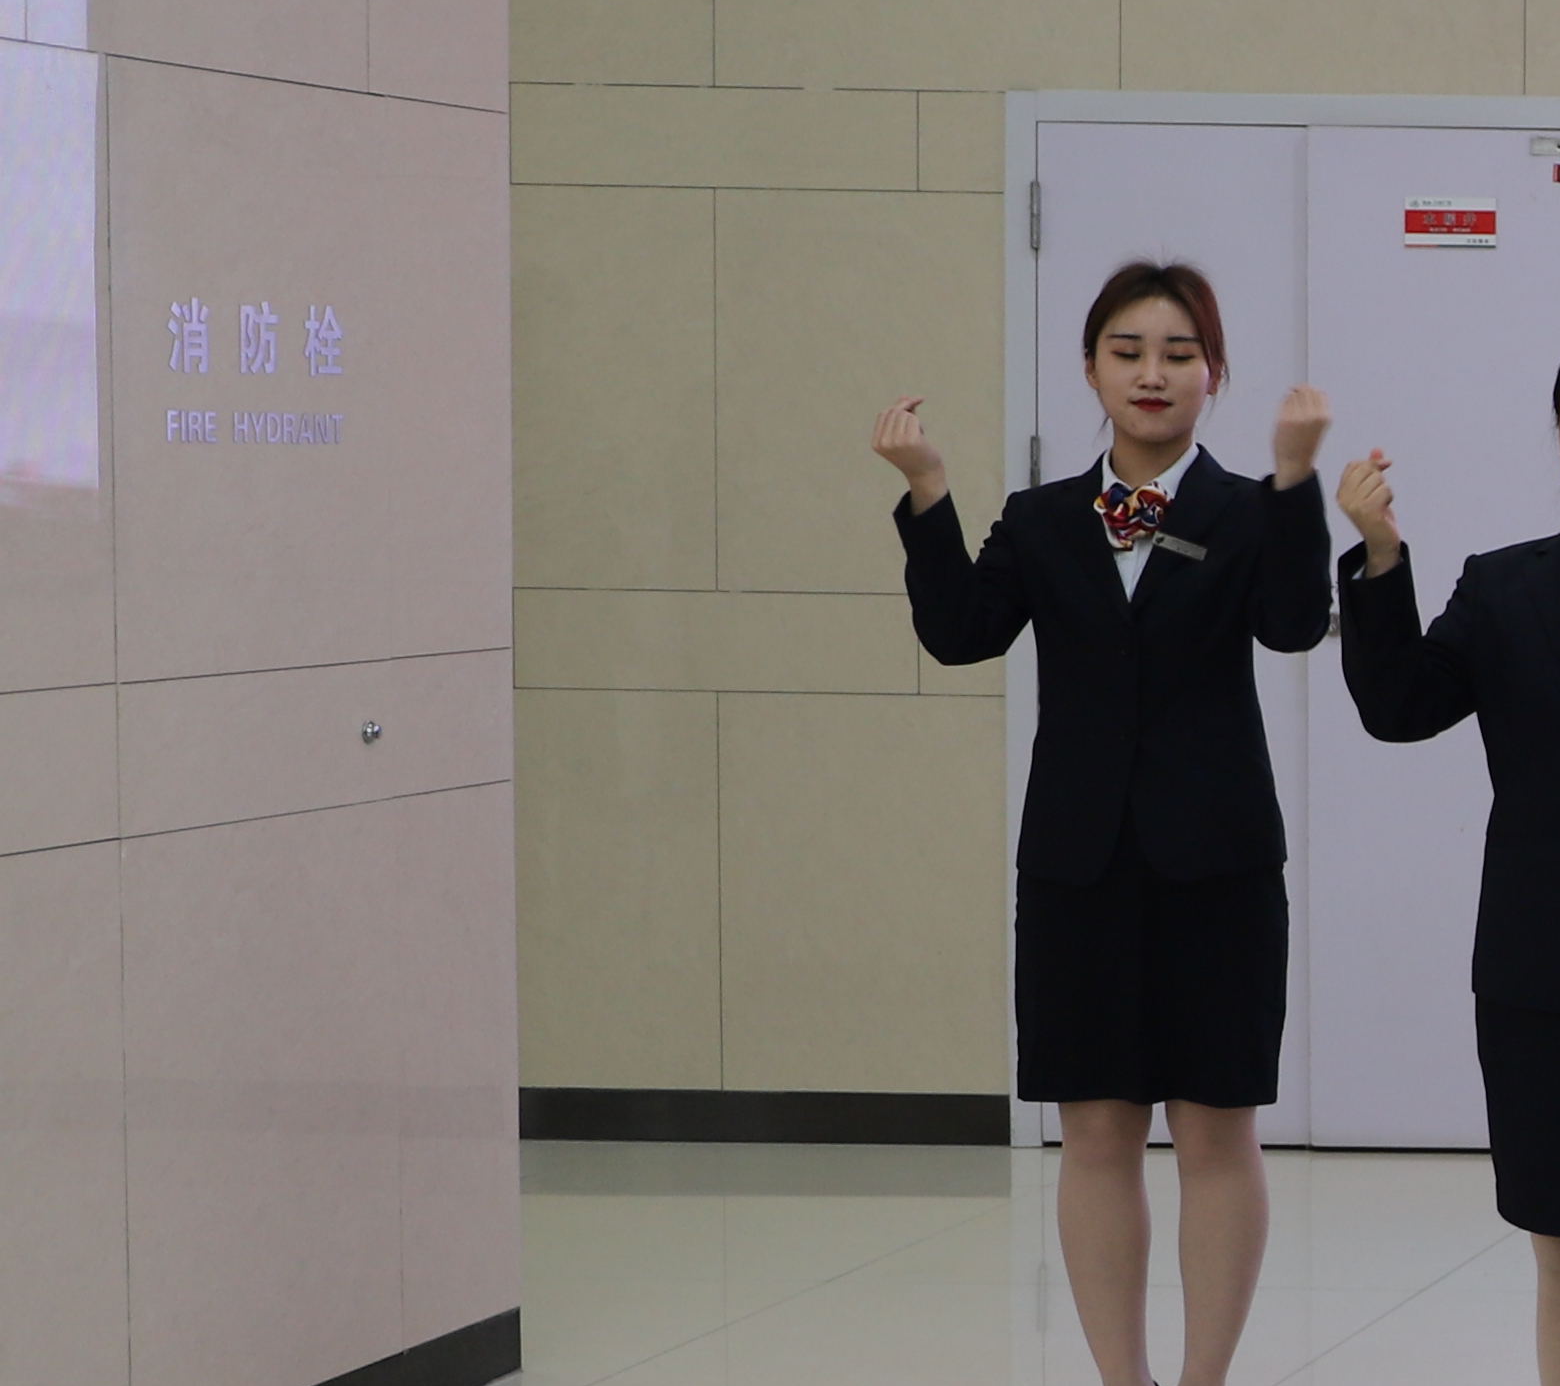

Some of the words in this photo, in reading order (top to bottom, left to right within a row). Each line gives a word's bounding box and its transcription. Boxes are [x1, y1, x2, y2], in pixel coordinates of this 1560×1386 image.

[167, 297, 344, 376] 消防栓
[165, 409, 217, 442] FIRE
[233, 411, 344, 444] HYDRANT
